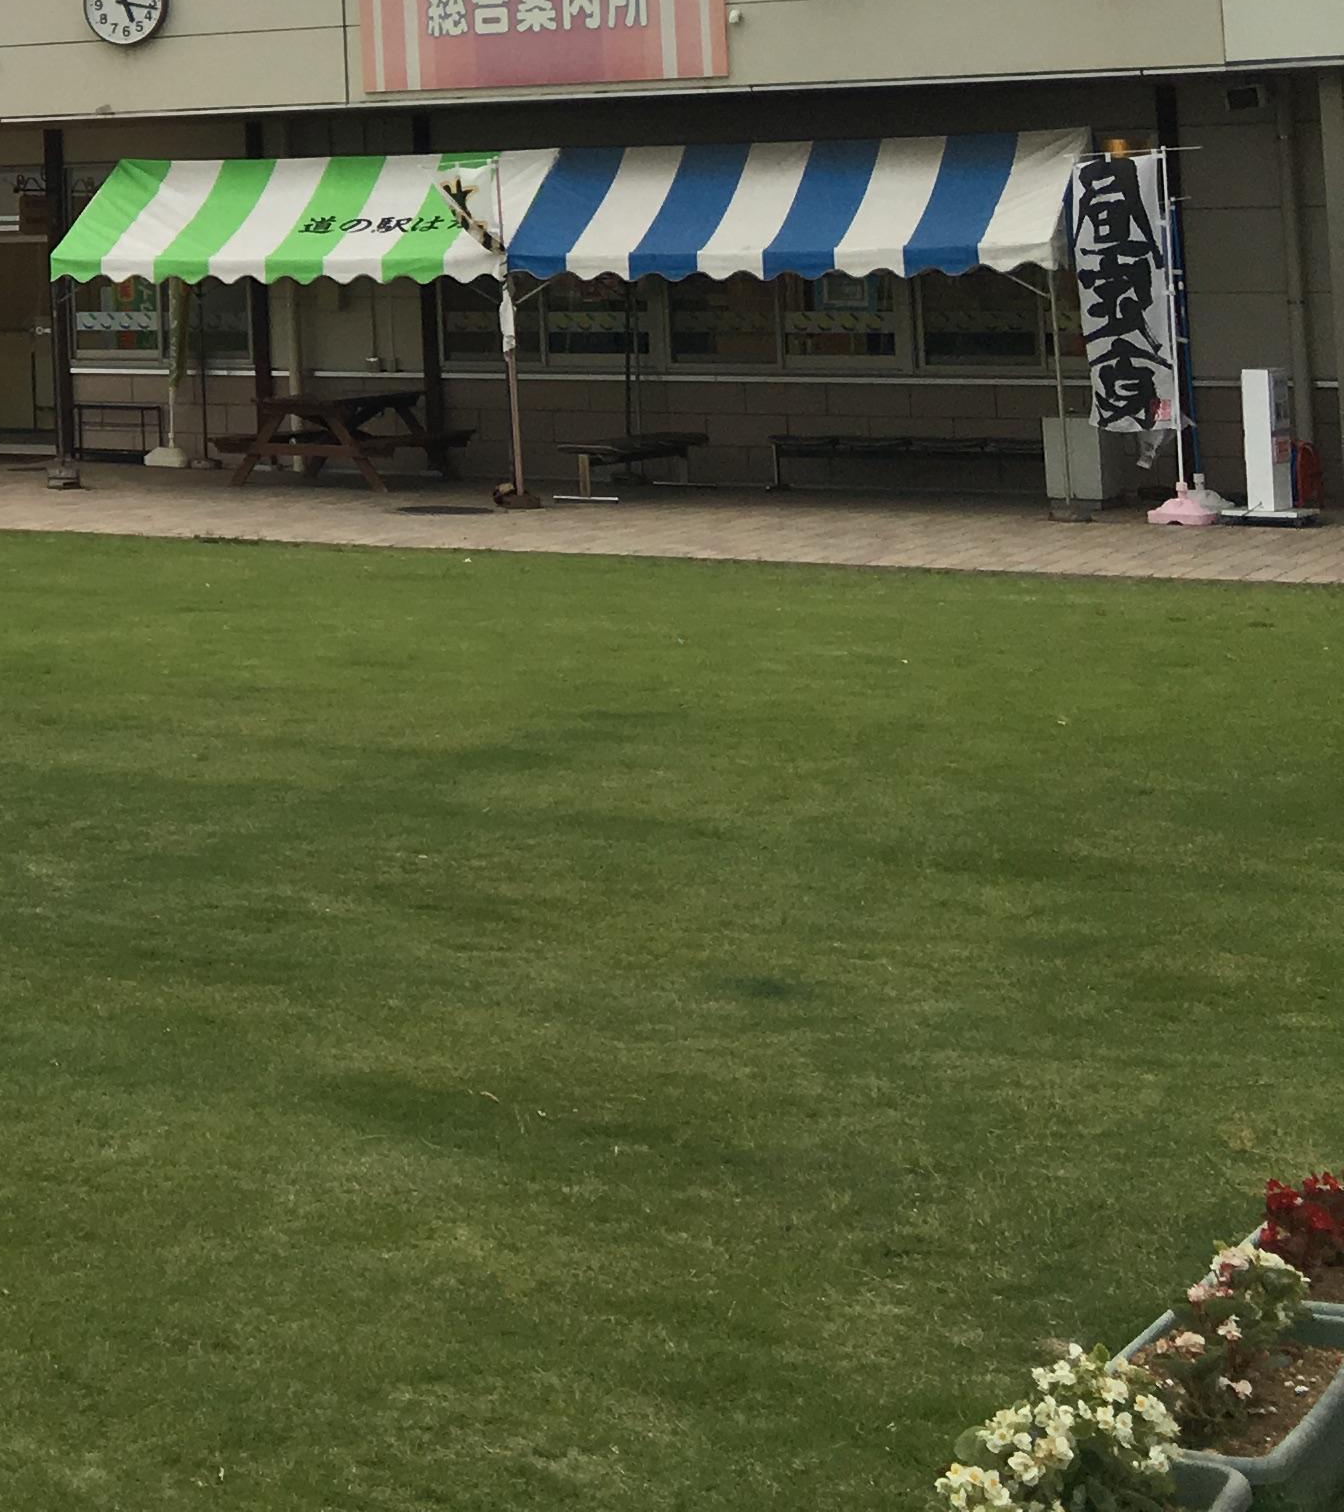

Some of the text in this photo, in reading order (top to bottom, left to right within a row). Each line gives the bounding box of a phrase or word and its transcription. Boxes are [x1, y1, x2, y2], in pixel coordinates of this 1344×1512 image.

[94, 0, 103, 10] 9
[99, 13, 107, 24] 8
[144, 11, 152, 21] 4
[111, 23, 118, 33] 7
[122, 26, 130, 37] 6
[135, 21, 143, 32] 5
